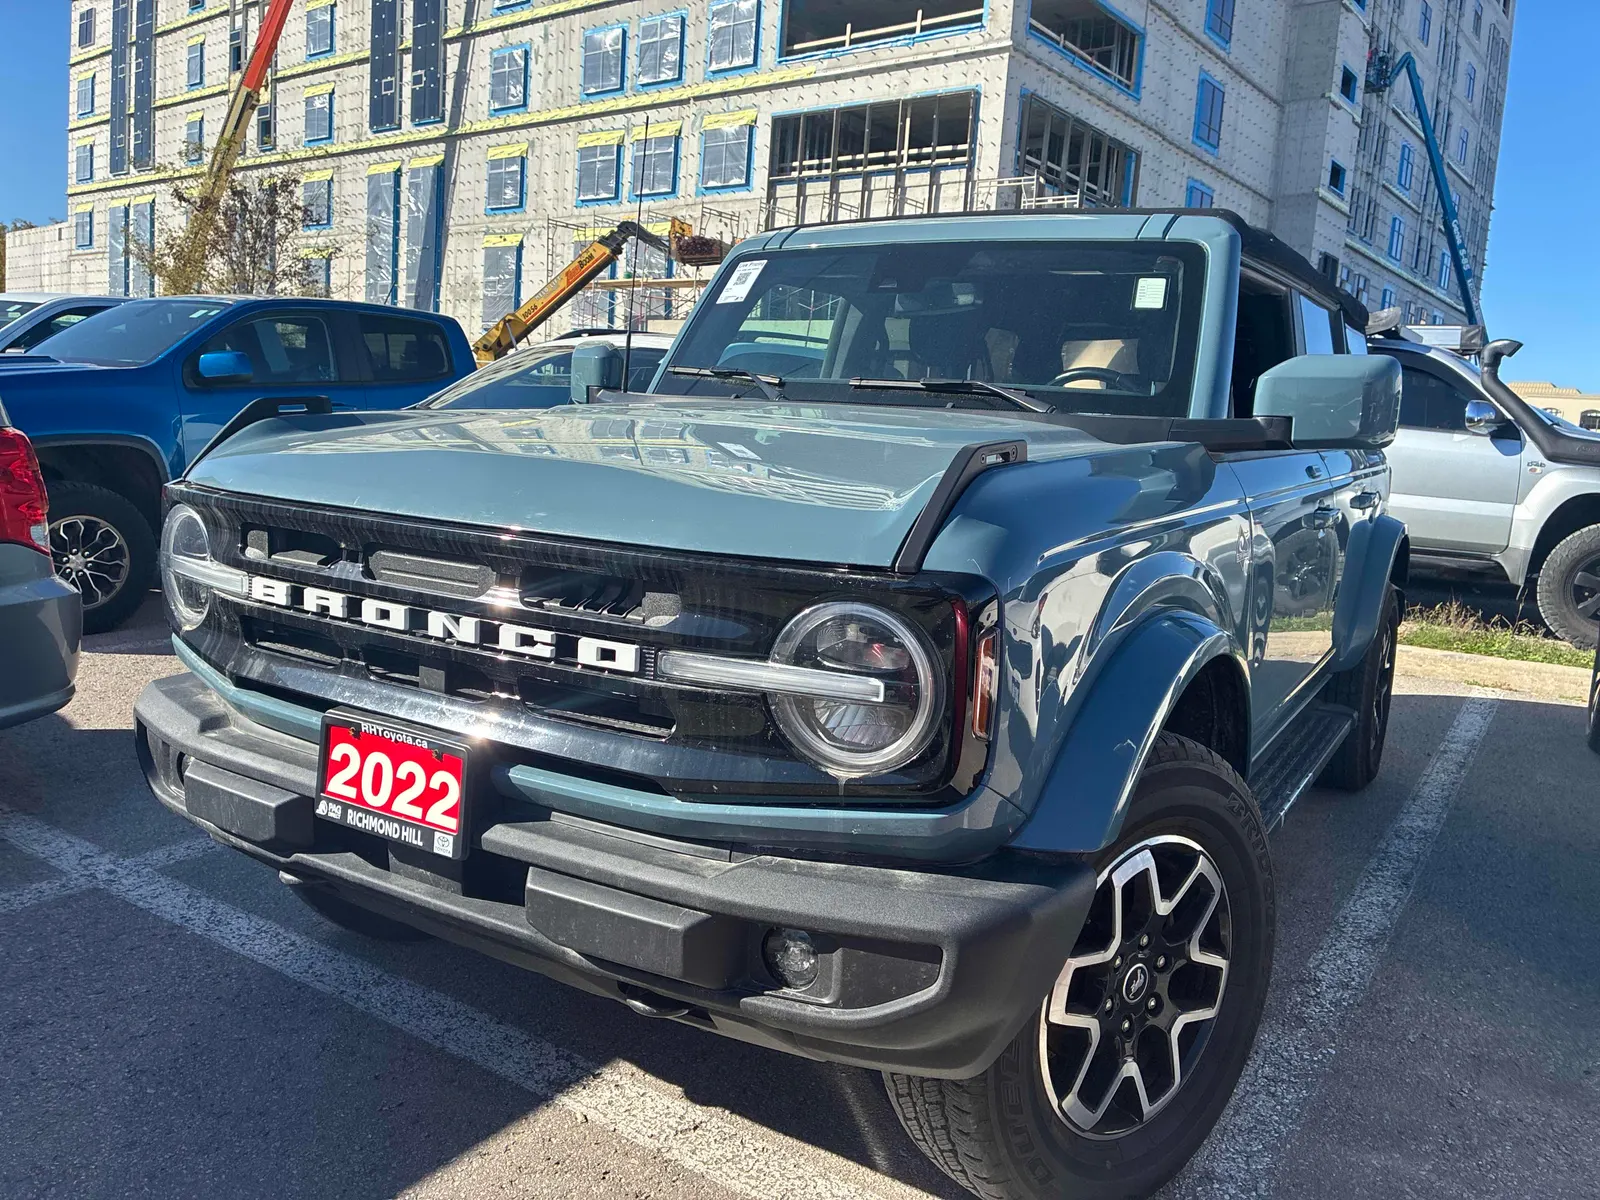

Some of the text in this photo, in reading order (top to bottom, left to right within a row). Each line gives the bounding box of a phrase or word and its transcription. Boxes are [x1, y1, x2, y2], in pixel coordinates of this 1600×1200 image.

[1452, 219, 1470, 271] Genie S-85
[522, 304, 538, 319] 10056
[251, 575, 641, 673] BRONCO
[361, 723, 428, 749] RHToyota.ca
[327, 743, 460, 830] 2022
[347, 809, 423, 846] RICHMOND HILL
